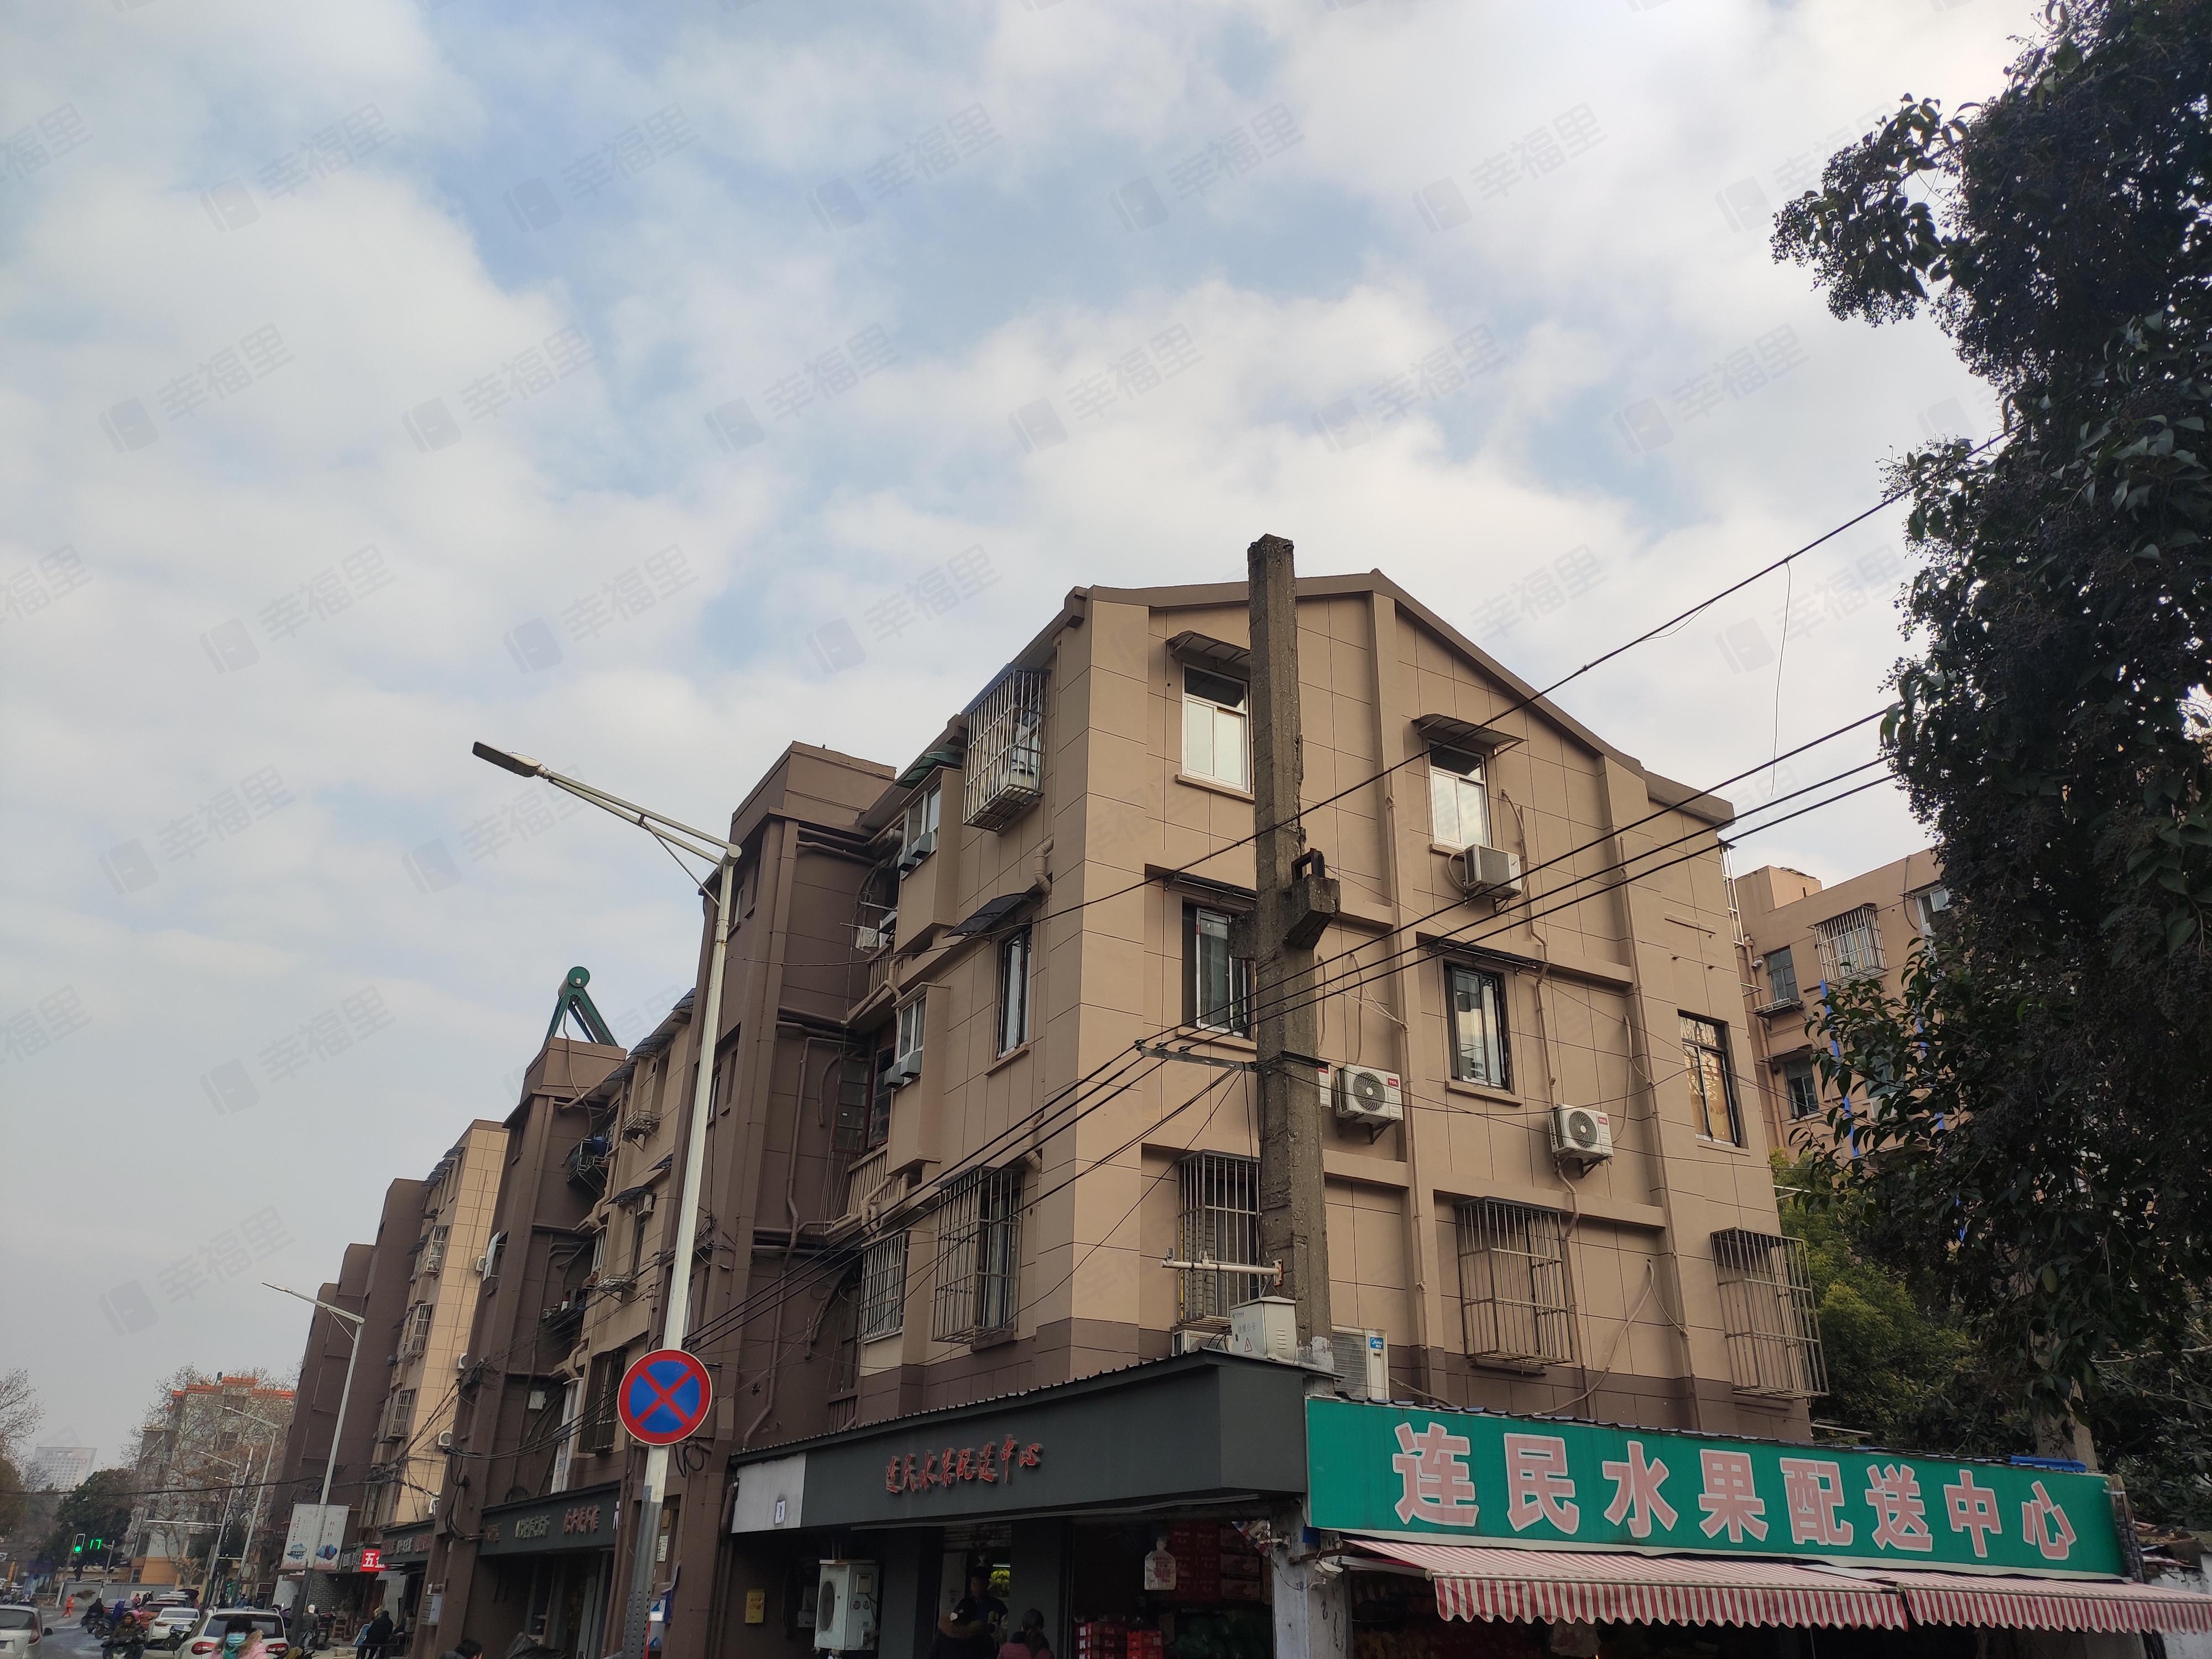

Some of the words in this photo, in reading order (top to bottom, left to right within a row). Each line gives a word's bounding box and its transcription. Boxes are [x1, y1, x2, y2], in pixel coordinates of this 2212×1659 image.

[1392, 1422, 2077, 1561] 连民水果配送中心
[90, 1539, 102, 1550] 17
